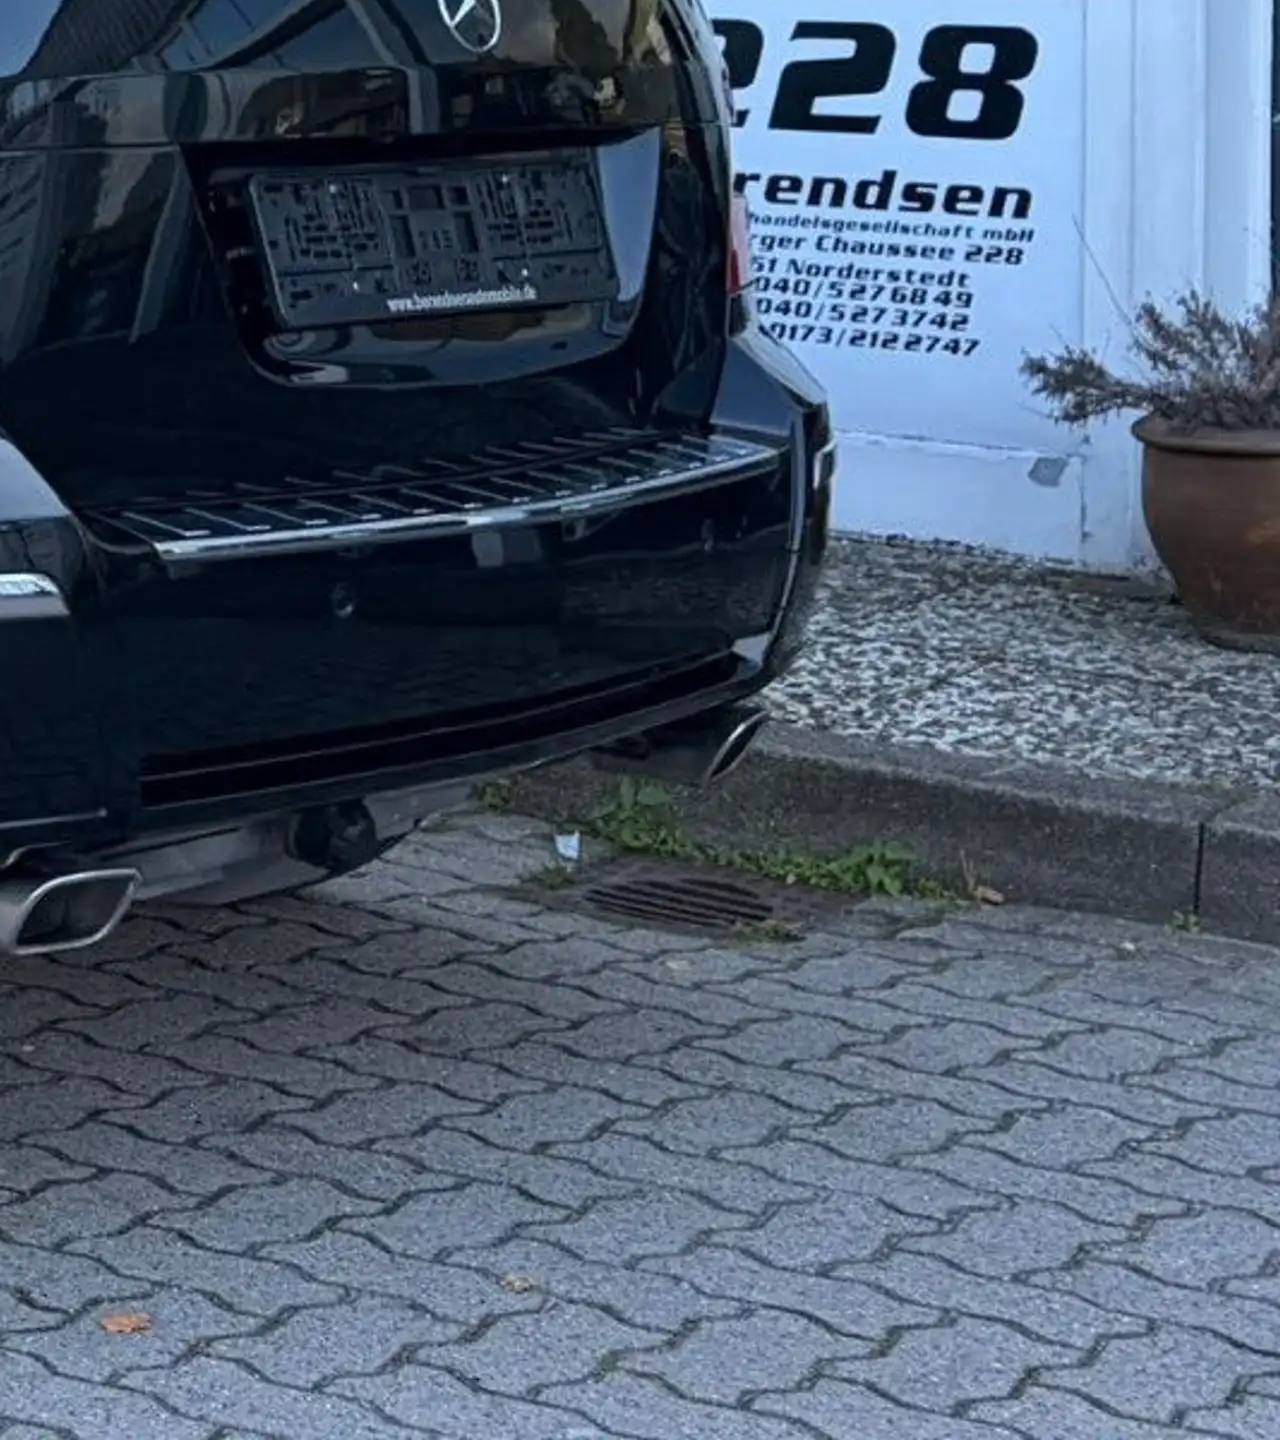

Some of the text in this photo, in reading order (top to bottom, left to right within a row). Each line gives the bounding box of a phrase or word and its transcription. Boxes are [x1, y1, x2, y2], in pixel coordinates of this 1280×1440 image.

[733, 169, 1033, 220] rendsen
[748, 211, 1036, 244] handelsgesellschaft mbH
[748, 231, 1025, 266] rger Chaussee 228
[749, 255, 972, 289] 51 Norderstedt
